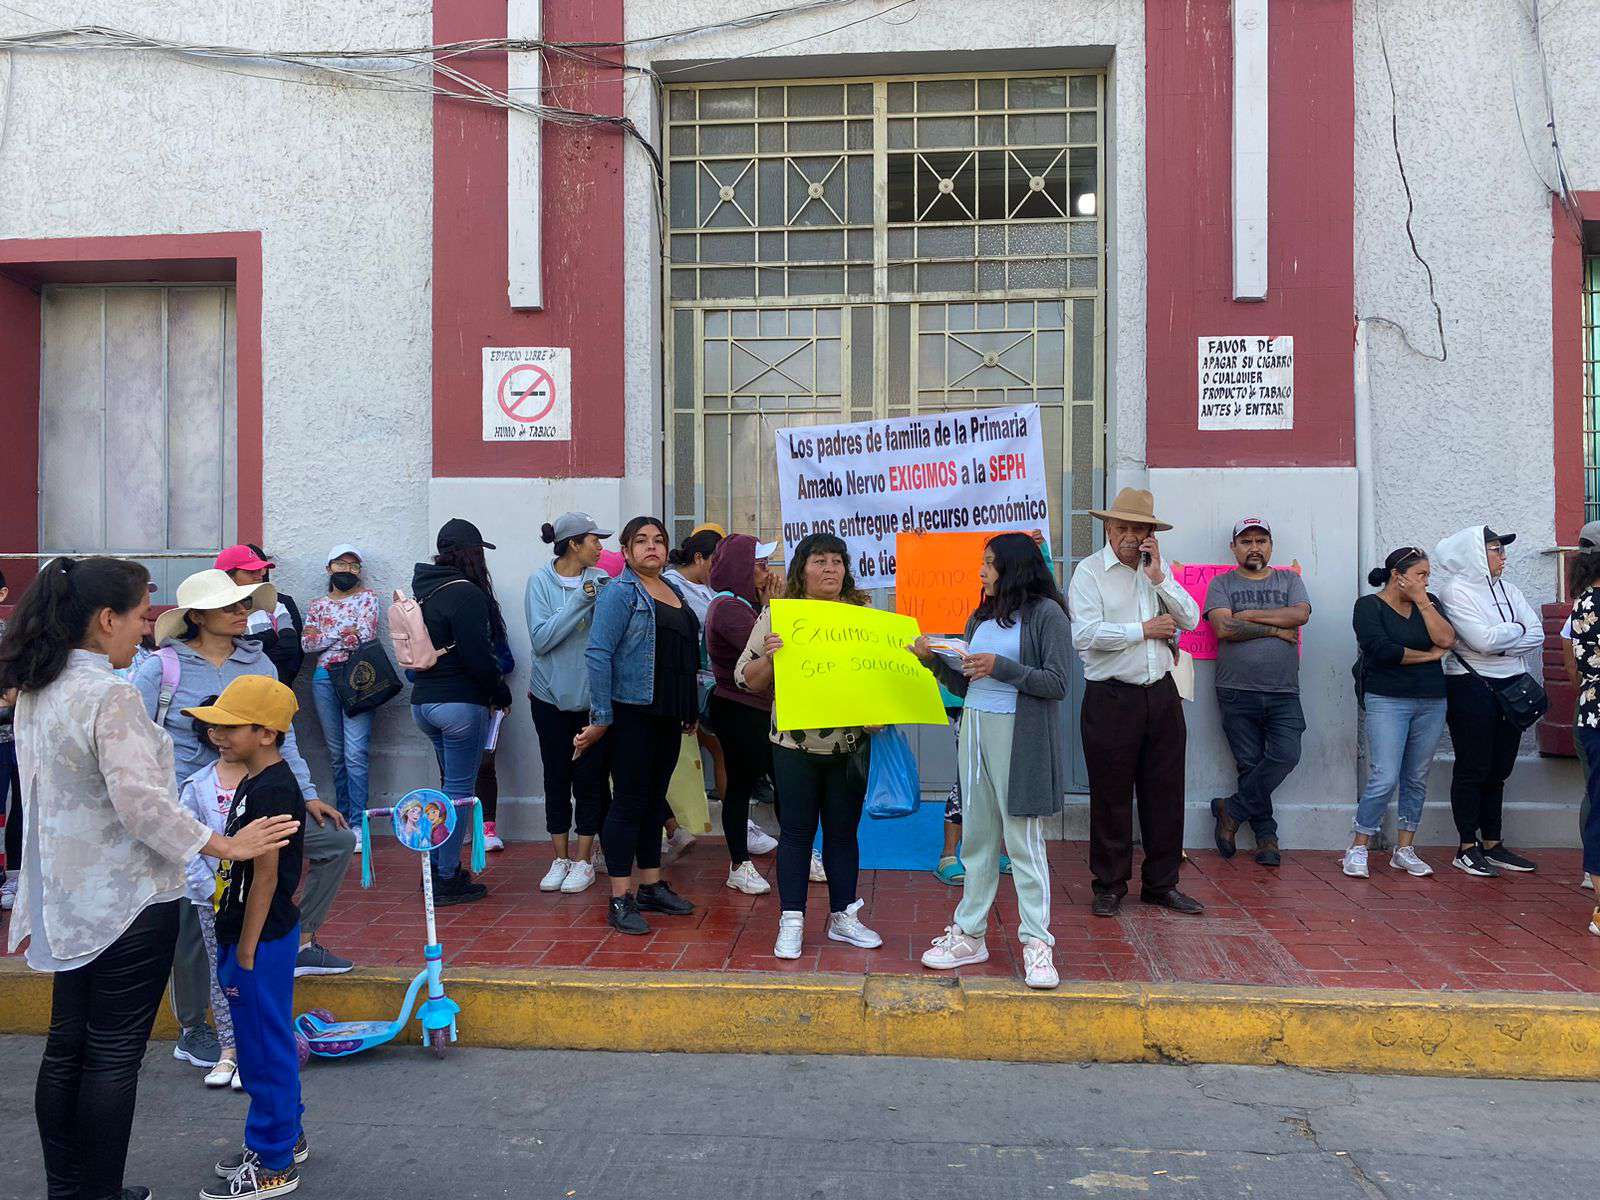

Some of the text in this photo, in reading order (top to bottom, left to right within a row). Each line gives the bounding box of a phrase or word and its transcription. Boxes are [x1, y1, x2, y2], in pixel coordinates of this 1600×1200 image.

[1208, 339, 1274, 353] FAVOR DE
[490, 350, 522, 361] EDIFICIO
[524, 350, 547, 361] LIBRE
[1202, 355, 1292, 369] APAGAR SU CIGARRO
[1203, 371, 1263, 384] O CUALQUIER
[1203, 387, 1248, 400] PRODUCTO
[1259, 386, 1292, 399] TABACO
[1201, 403, 1232, 417] ANTES
[1245, 402, 1284, 416] ENTRAR
[494, 426, 516, 438] HUMO
[529, 426, 556, 438] TABACO
[789, 412, 1028, 463] Los padres de familia de la Primaria
[798, 453, 1026, 500] Amado Nervo EXIGIMOS a la SEPH
[784, 496, 1047, 548] que nos entregue el recurso económico
[859, 551, 876, 578] de
[1230, 589, 1289, 608] PIRATES
[791, 618, 880, 646] EXIGIMOS
[801, 656, 920, 679] SEP SOLUCION
